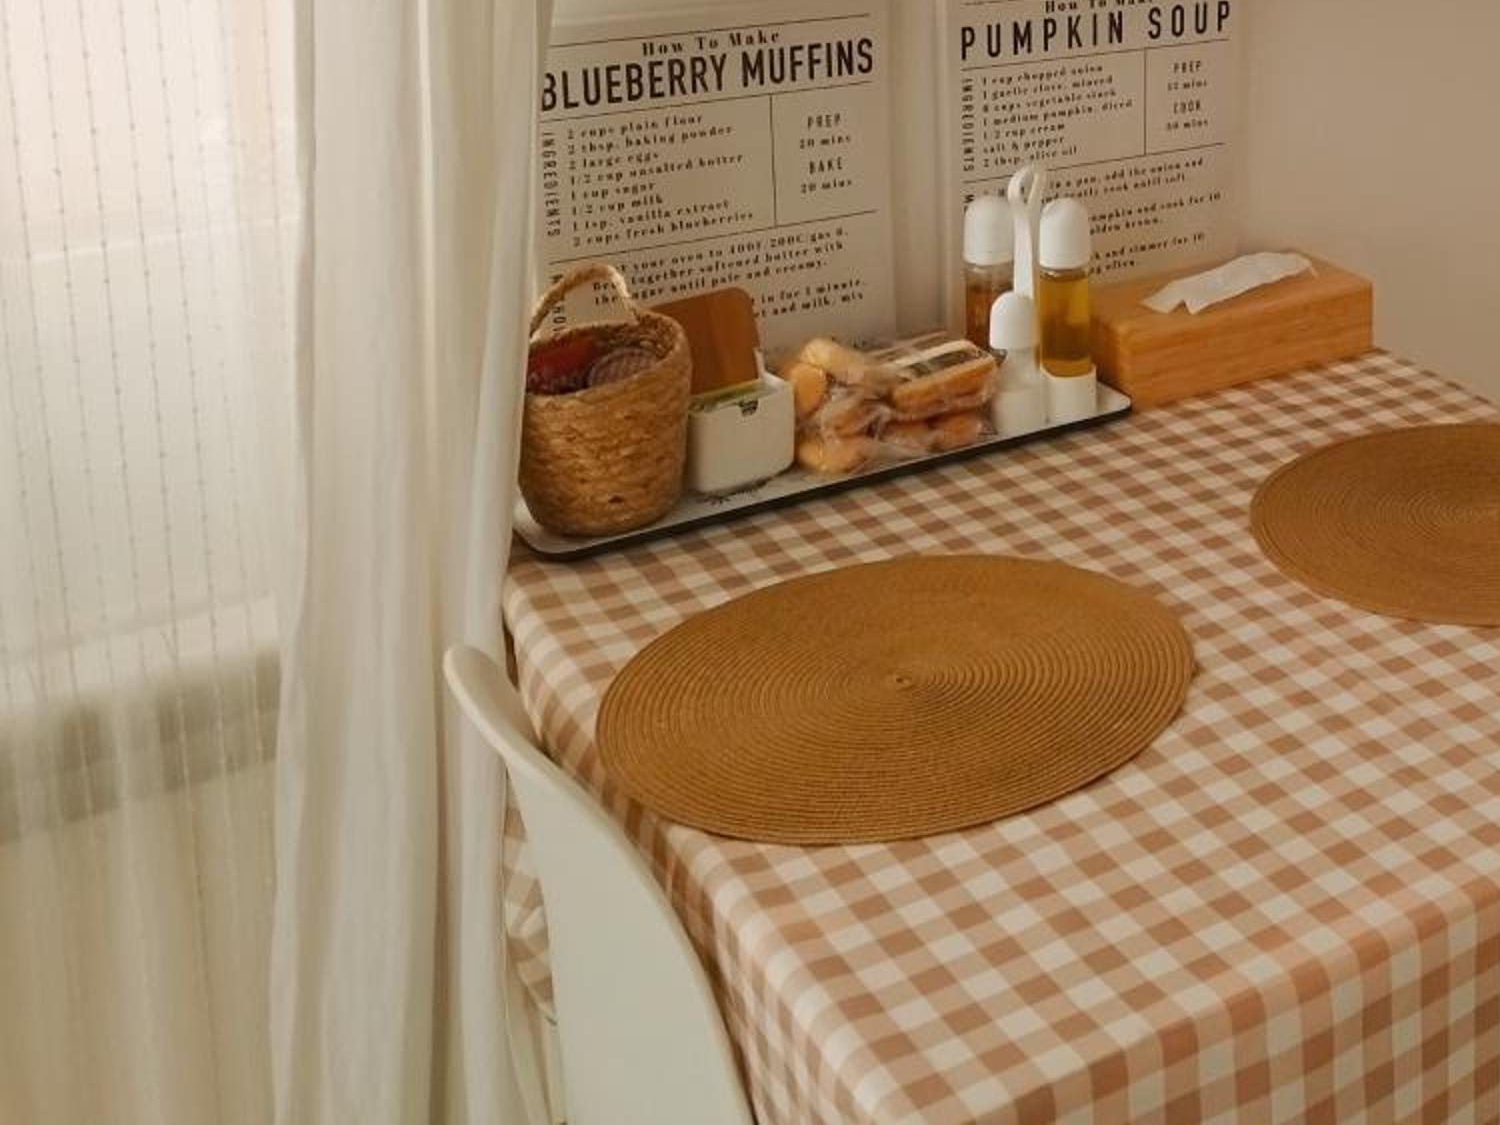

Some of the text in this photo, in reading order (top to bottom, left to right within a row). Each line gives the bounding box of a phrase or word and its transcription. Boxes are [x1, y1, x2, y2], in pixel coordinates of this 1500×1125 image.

[1045, 0, 1077, 14] How
[961, 0, 1231, 62] PUMPKIN SOUP
[642, 29, 780, 57] How To Make
[541, 37, 873, 112] BLUEBERRY MUFFINS
[807, 113, 841, 131] PREP
[808, 156, 843, 175] BAKE
[543, 131, 561, 237] INGREDIENTS
[1088, 207, 1133, 222] umpkin
[1089, 222, 1121, 236] olden
